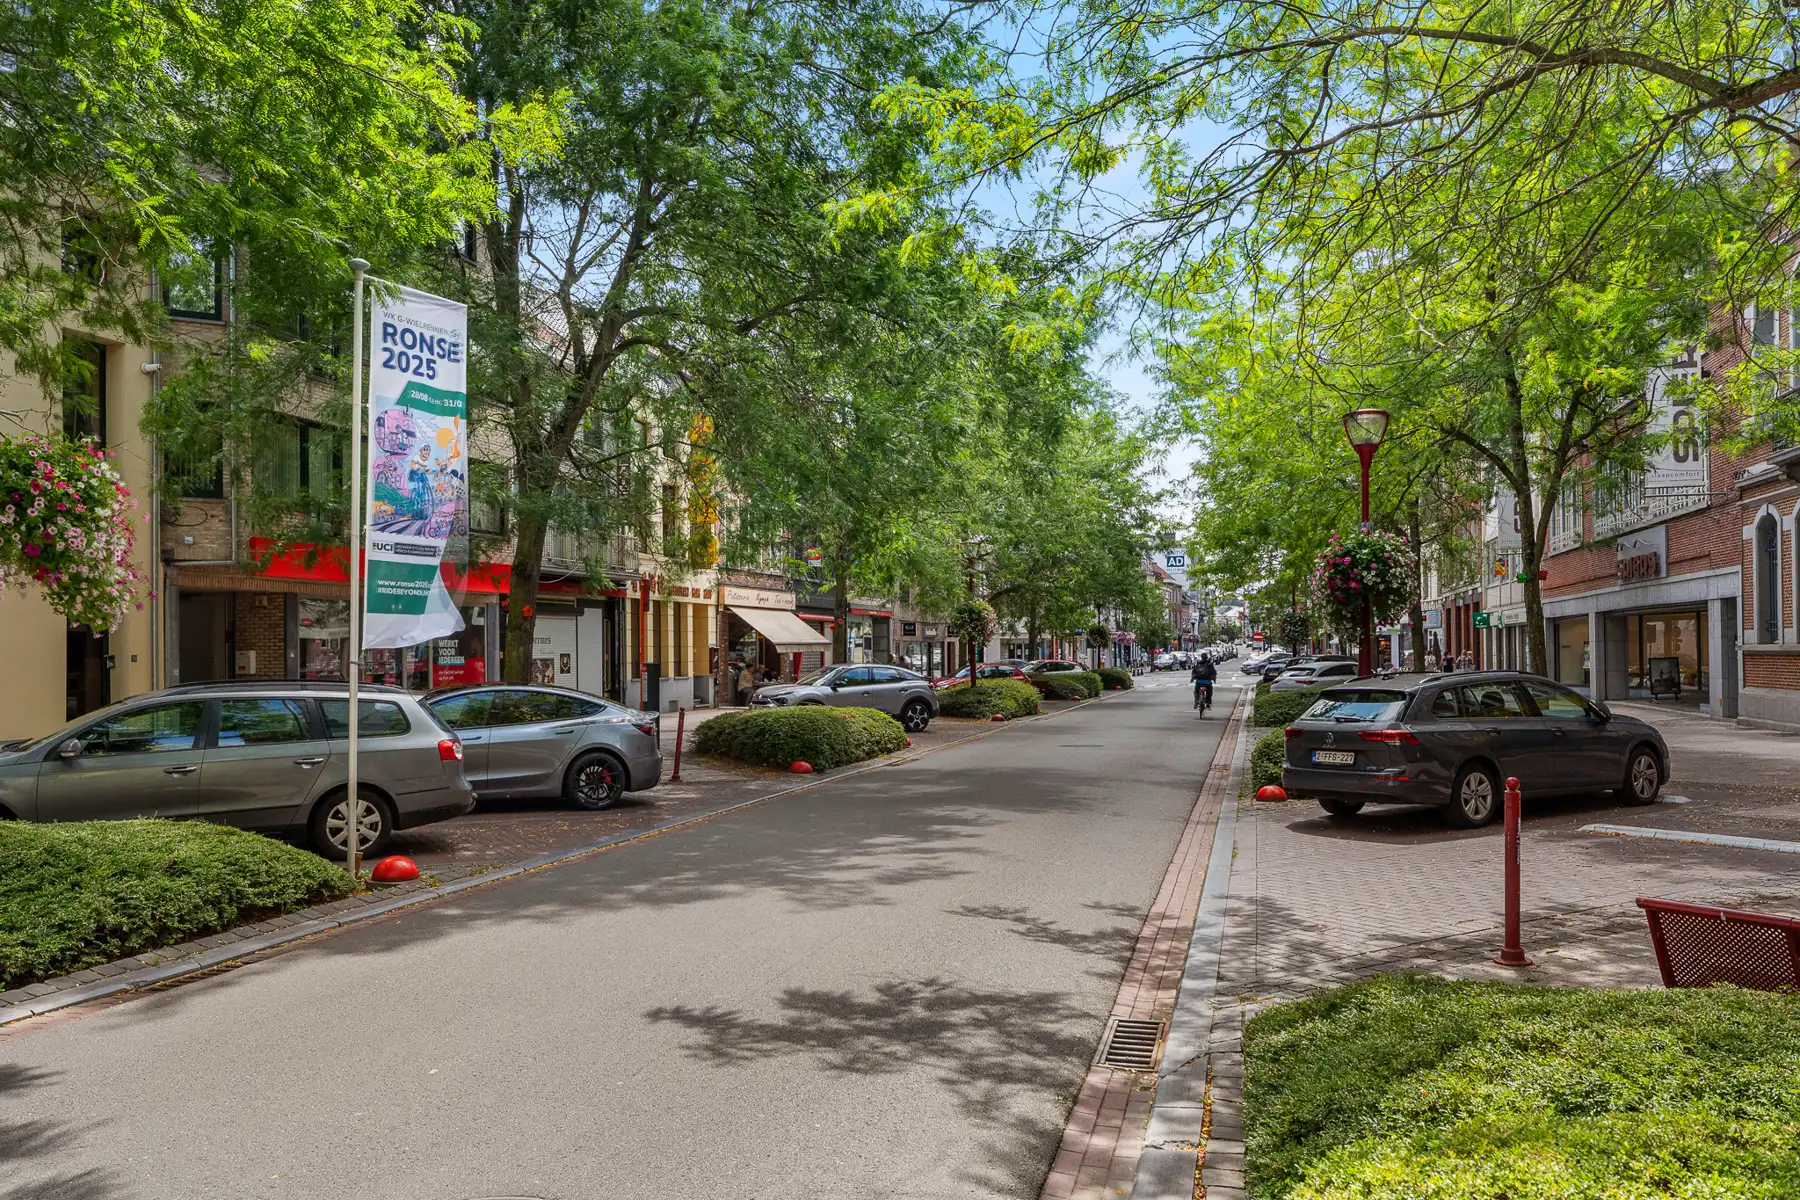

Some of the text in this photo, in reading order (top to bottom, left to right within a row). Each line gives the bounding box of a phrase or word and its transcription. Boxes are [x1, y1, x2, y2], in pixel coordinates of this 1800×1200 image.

[383, 311, 396, 320] WK
[382, 321, 462, 363] RONSE
[382, 347, 438, 380] 2025
[376, 542, 393, 552] UCI
[1168, 557, 1184, 566] AD
[438, 655, 465, 664] IEDEREEN
